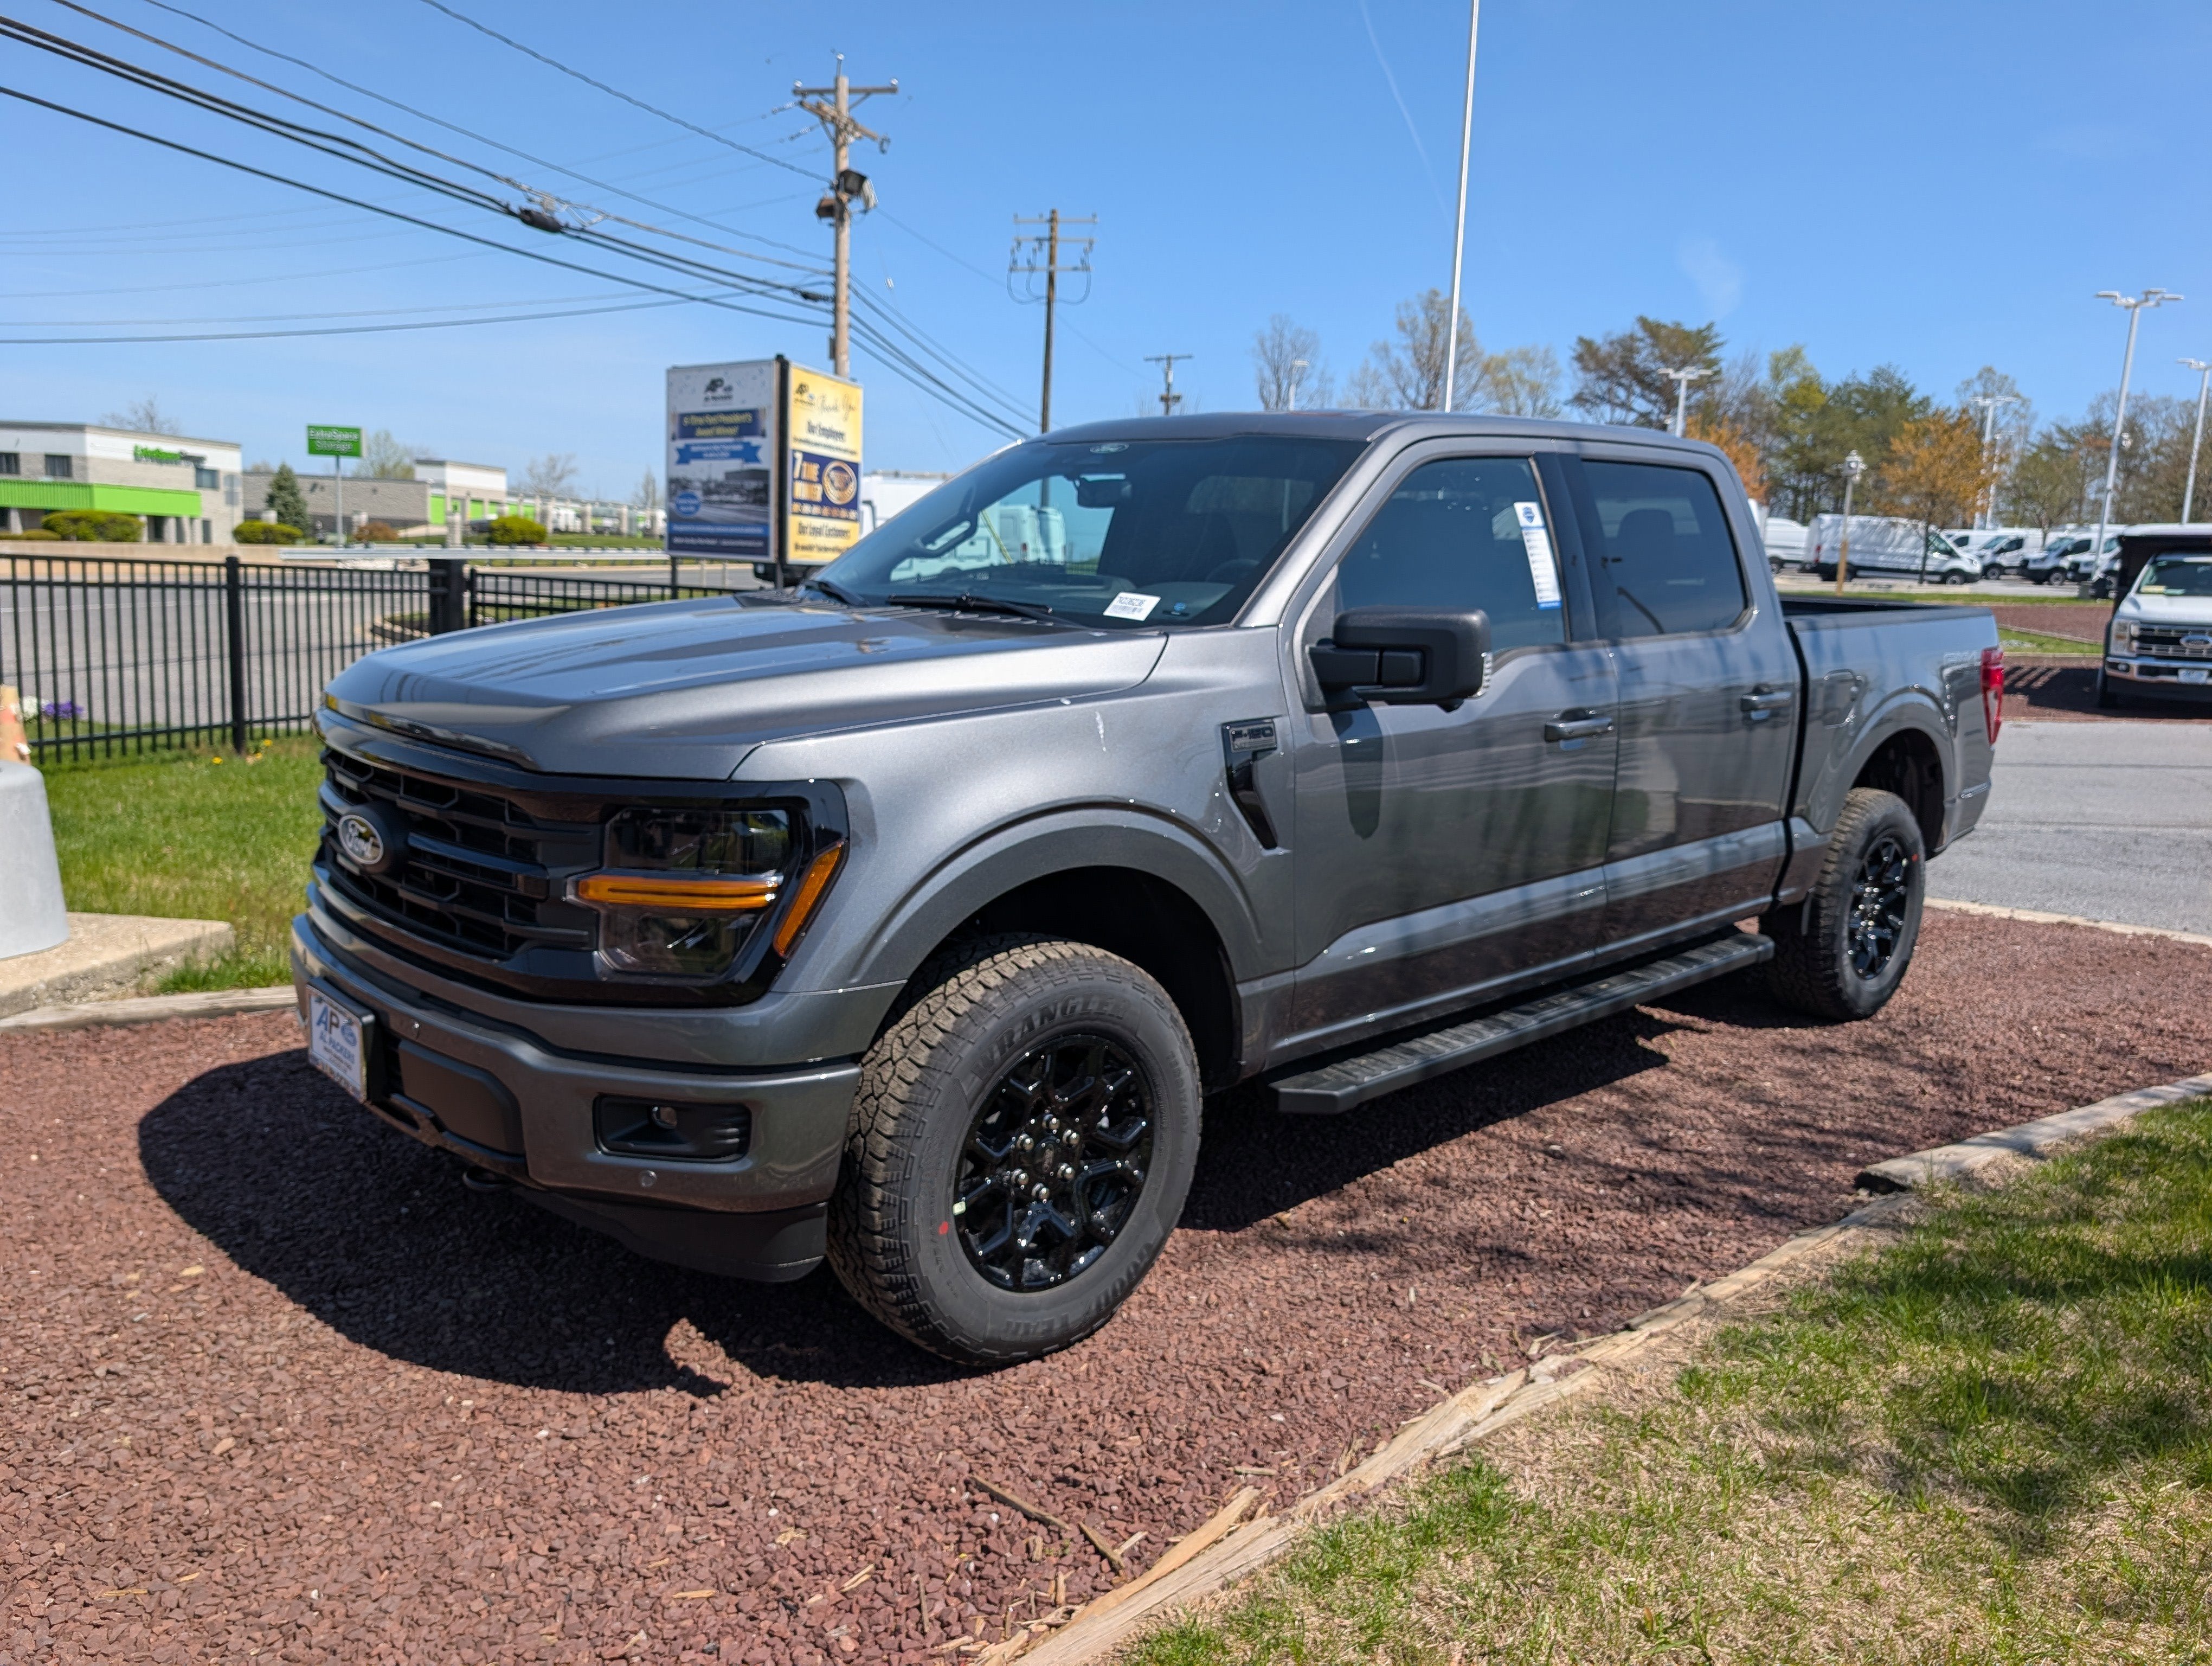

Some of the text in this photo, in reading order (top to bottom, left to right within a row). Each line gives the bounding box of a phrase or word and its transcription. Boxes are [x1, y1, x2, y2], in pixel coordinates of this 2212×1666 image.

[345, 819, 375, 859] Ford
[316, 1005, 340, 1034] AP
[970, 994, 1130, 1080] WRANGLER
